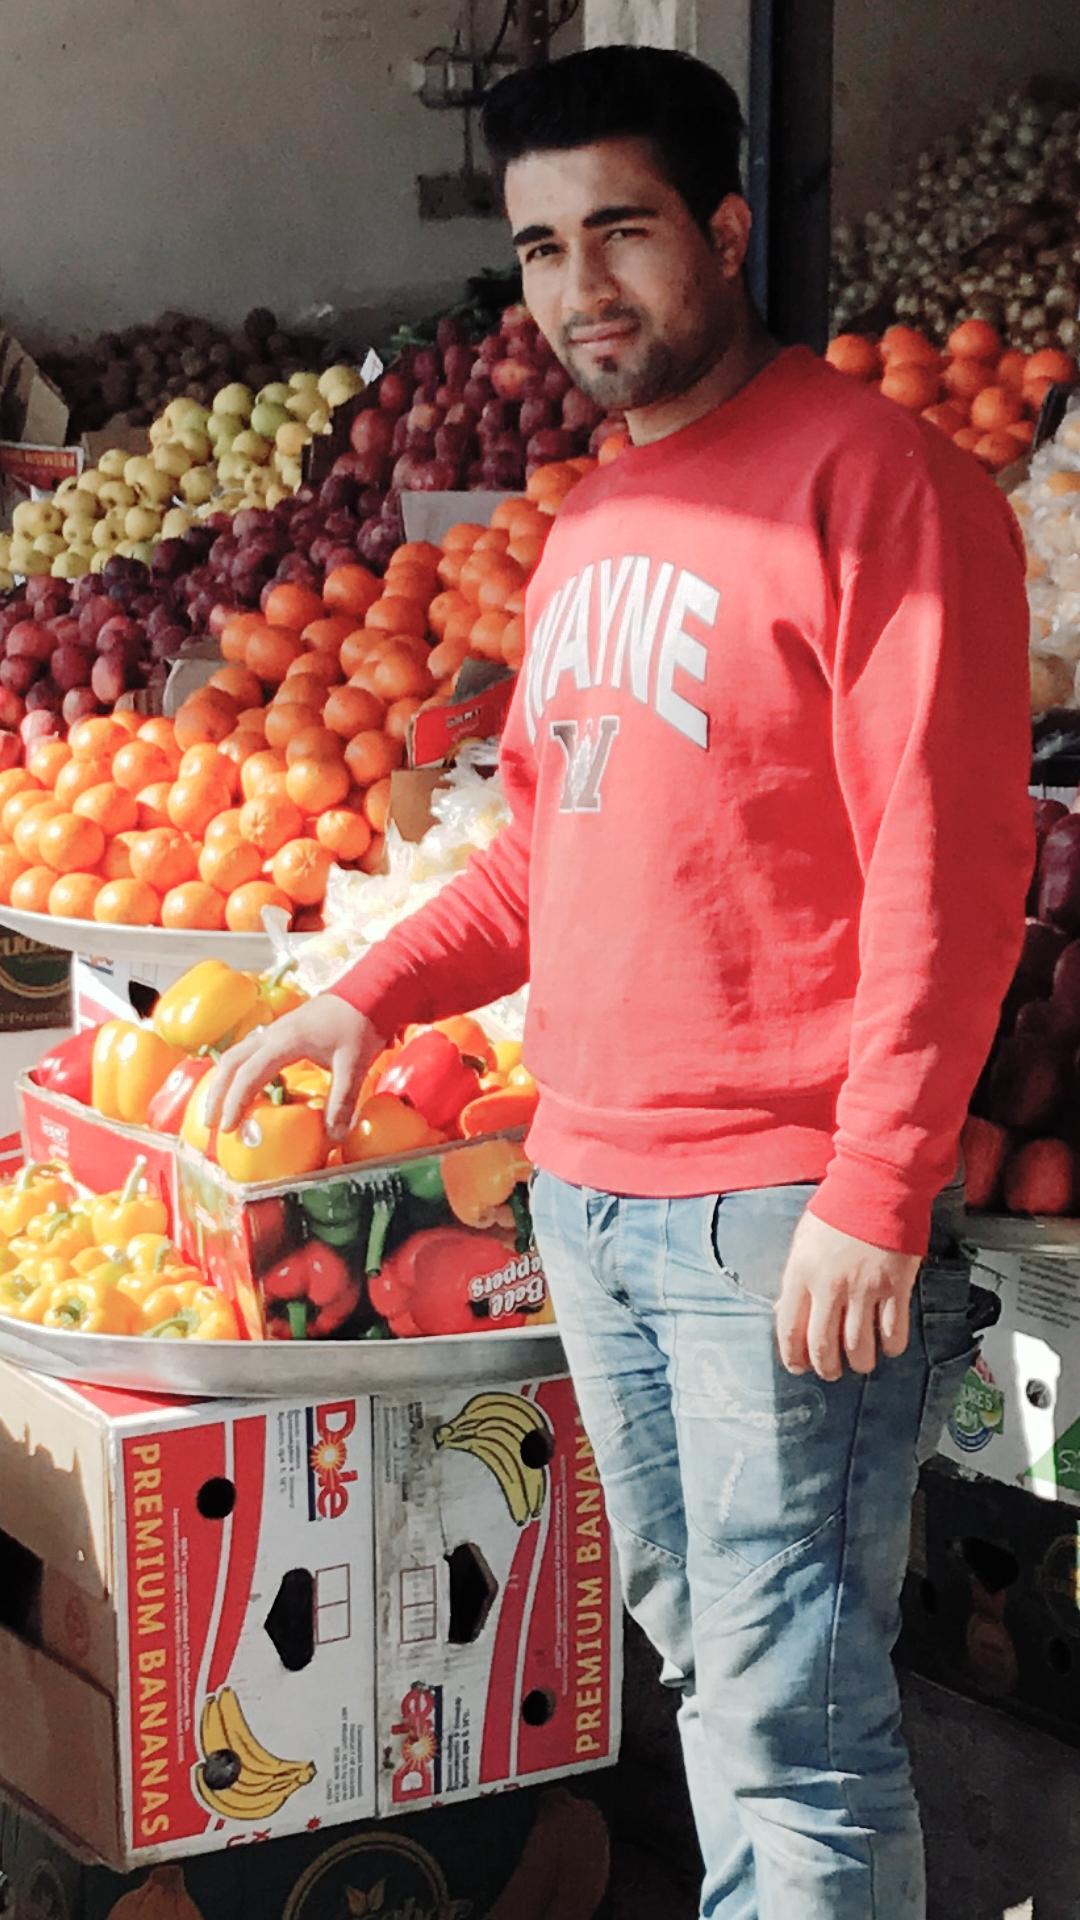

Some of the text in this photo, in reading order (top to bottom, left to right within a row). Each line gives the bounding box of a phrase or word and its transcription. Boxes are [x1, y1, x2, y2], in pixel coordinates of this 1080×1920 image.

[524, 556, 720, 750] WAYNE
[470, 1256, 542, 1299] eppers
[313, 1401, 358, 1518] Dole
[130, 1443, 169, 1835] PREMIUM BANANAS
[575, 1420, 603, 1753] PREMIUM BANAN
[392, 1689, 436, 1802] Dole
